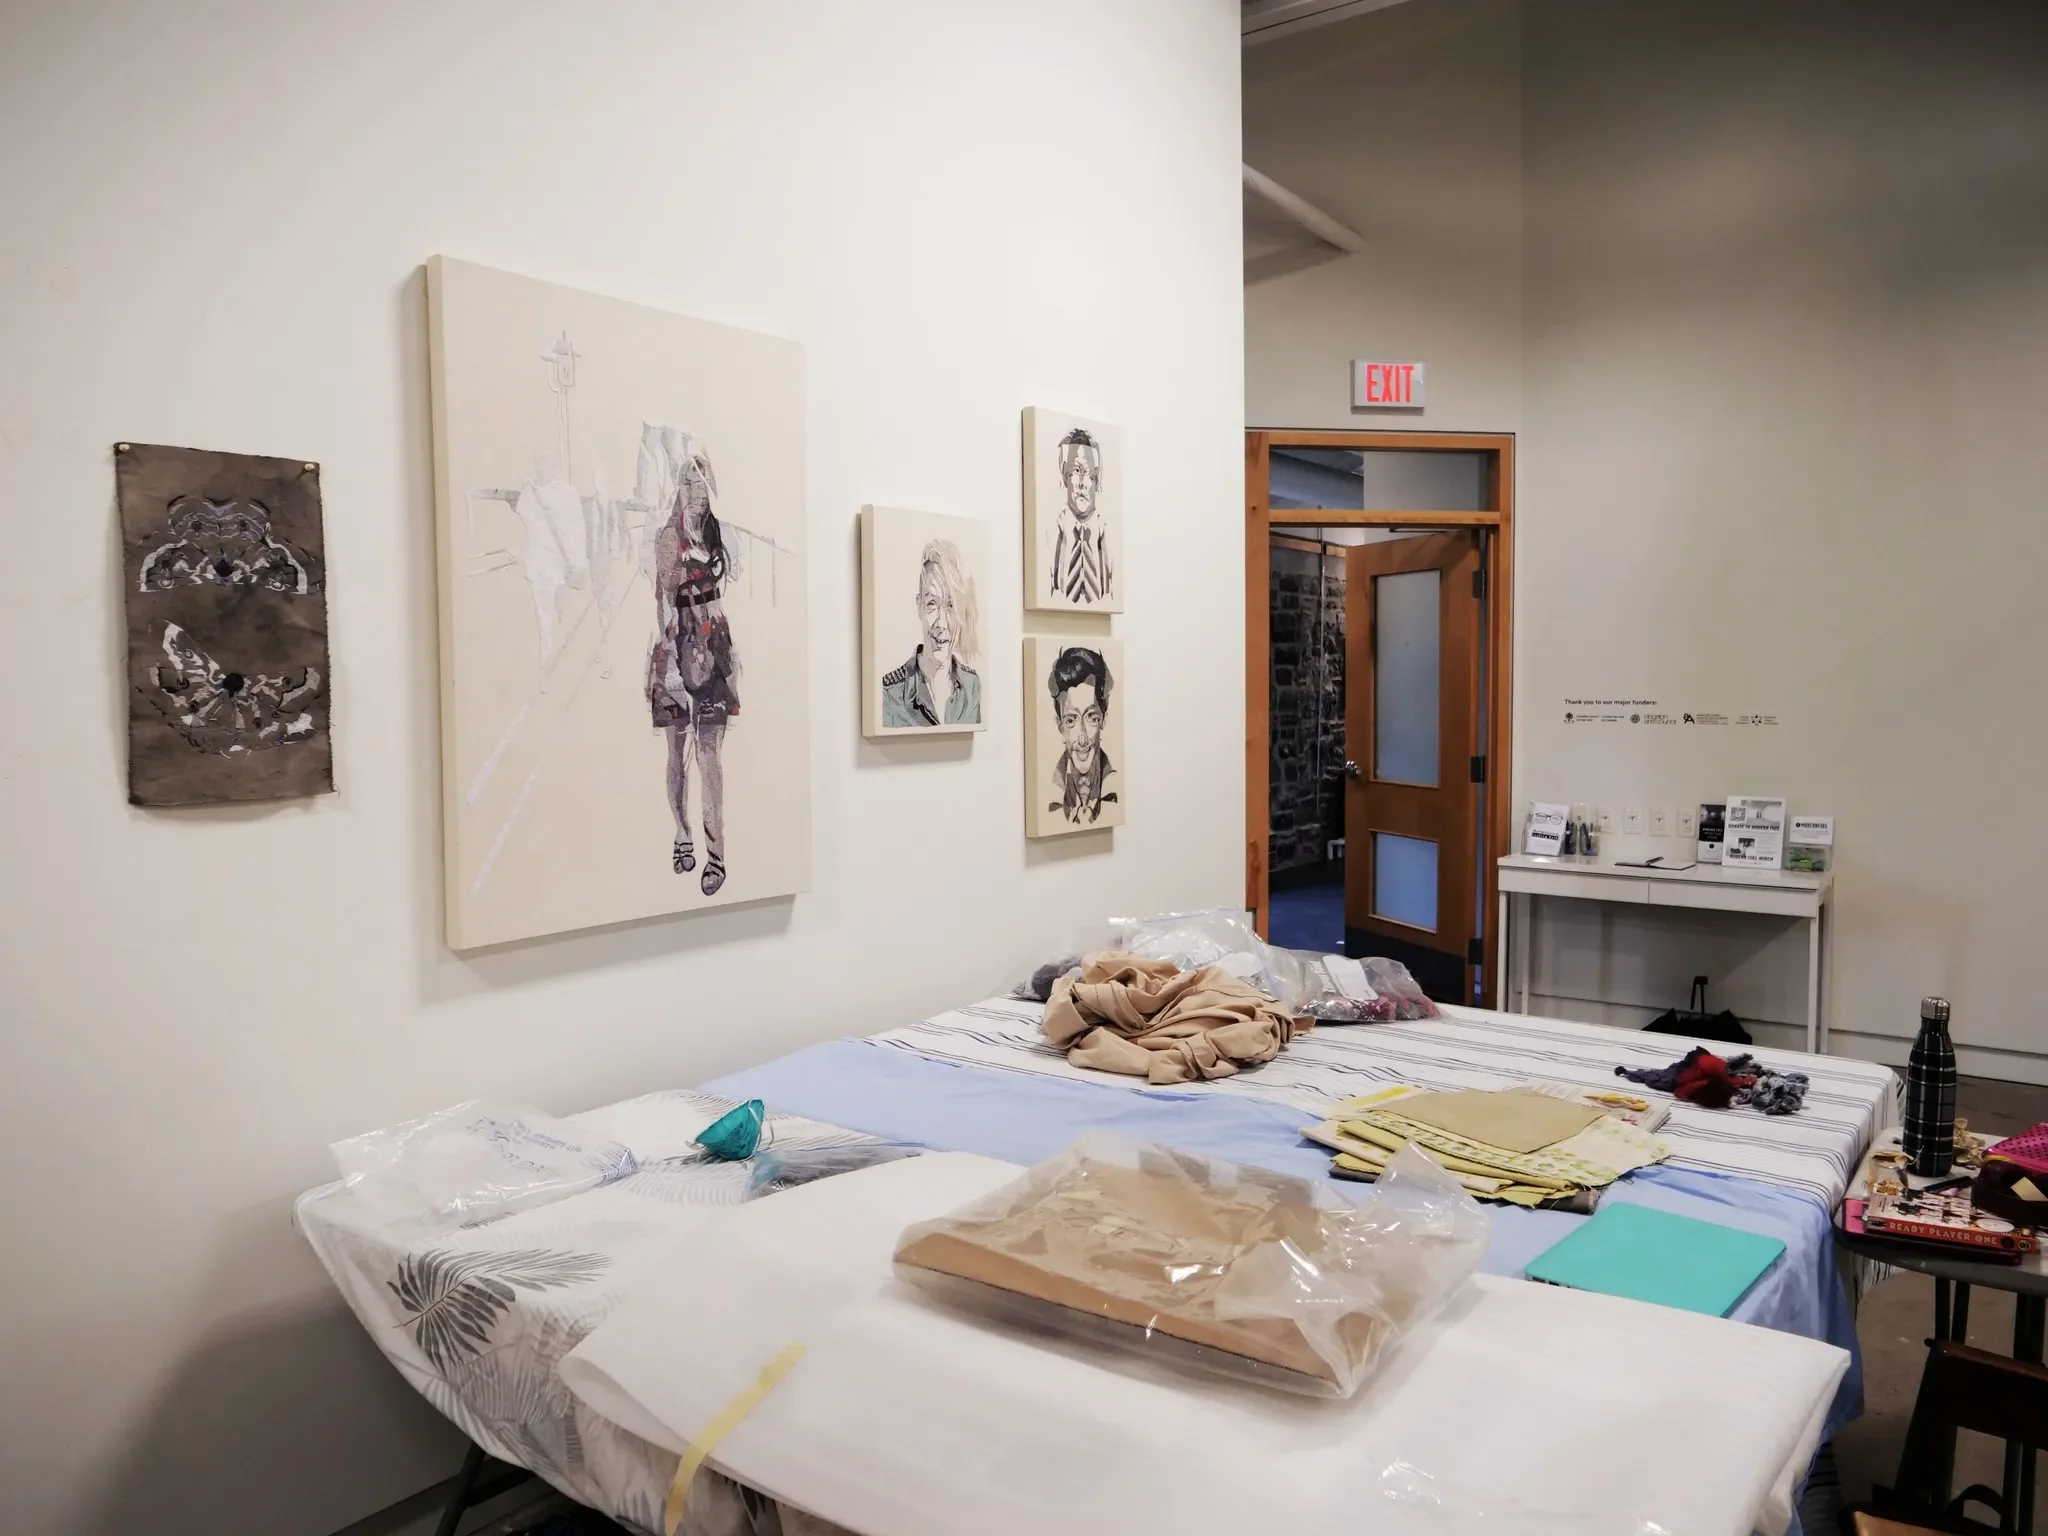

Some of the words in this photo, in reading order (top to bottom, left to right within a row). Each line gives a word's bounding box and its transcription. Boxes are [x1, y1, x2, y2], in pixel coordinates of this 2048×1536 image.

[1366, 363, 1415, 403] EXIT
[1889, 1222, 1925, 1234] READY
[1929, 1228, 1970, 1240] PLAYER
[1975, 1234, 1998, 1245] ONE
